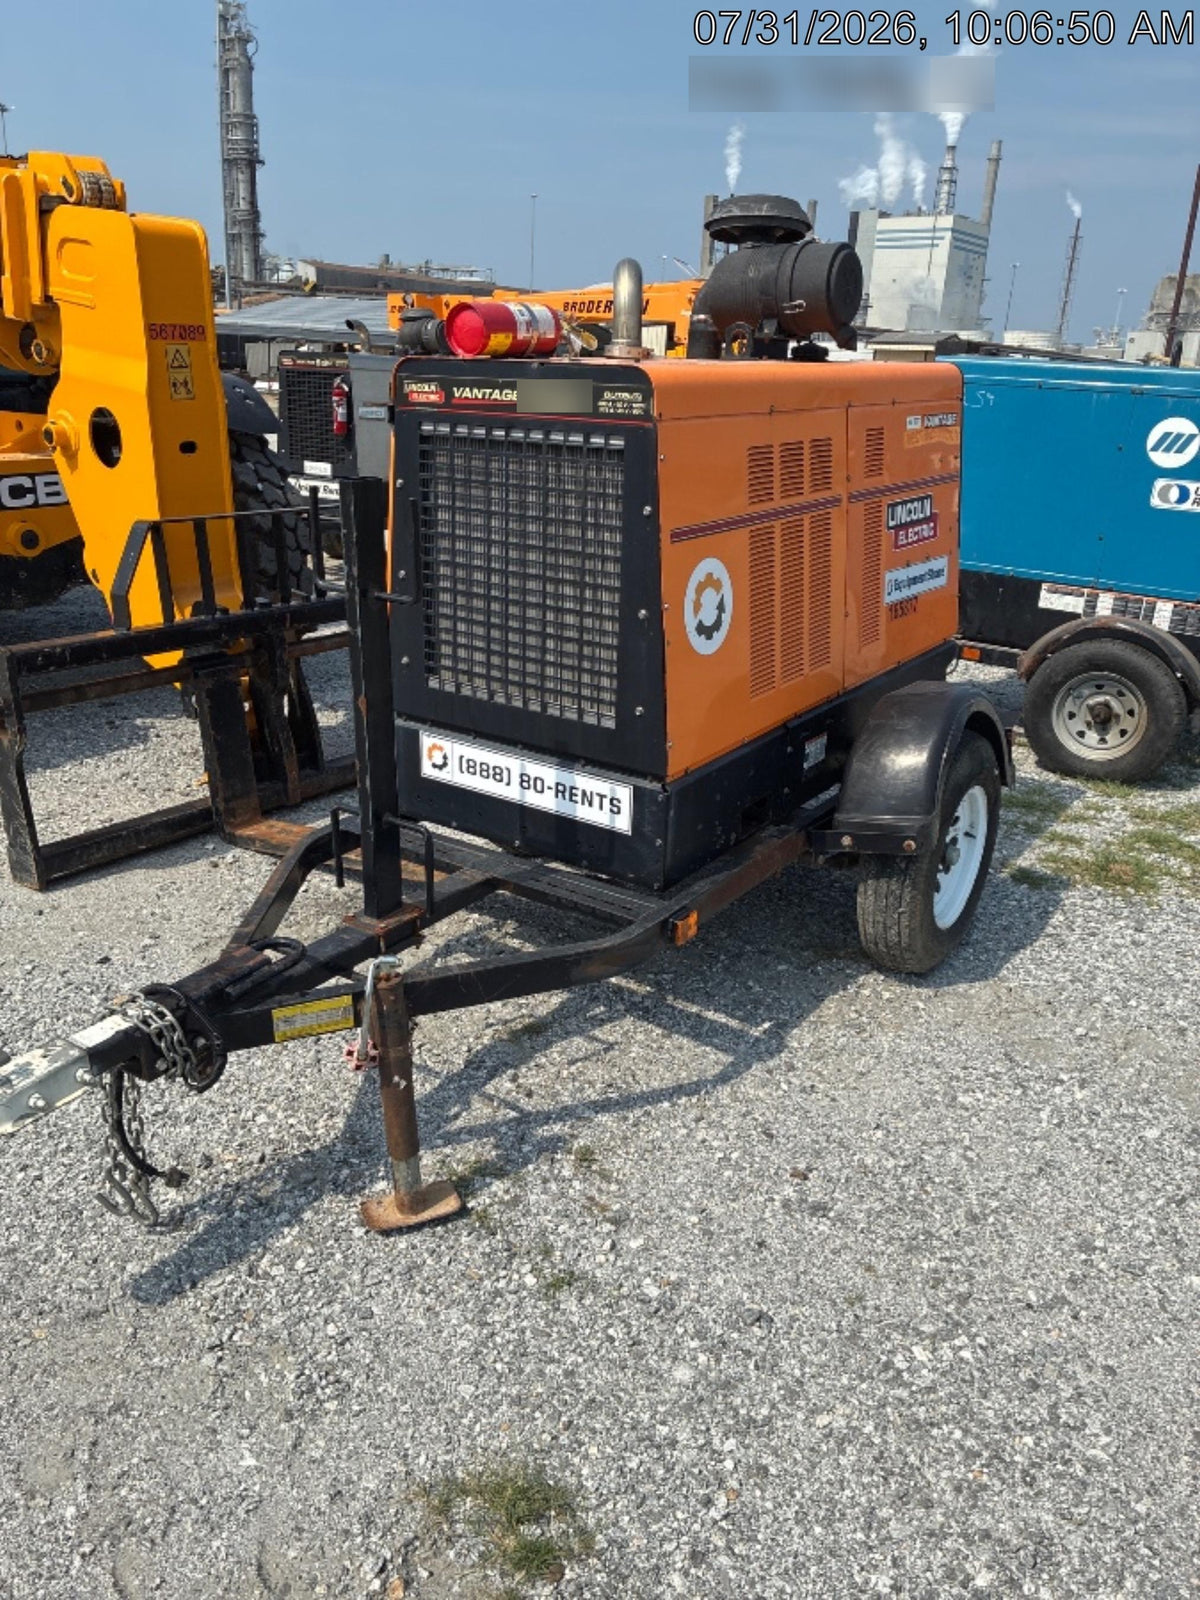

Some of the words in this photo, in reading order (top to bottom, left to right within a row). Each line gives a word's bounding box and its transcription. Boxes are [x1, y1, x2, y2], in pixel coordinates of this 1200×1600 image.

[563, 299, 649, 315] BRODER
[0, 474, 67, 507] CB
[888, 498, 931, 527] LINCOLN
[898, 522, 935, 546] ELECTRIC
[458, 754, 511, 786] (888)
[519, 772, 622, 815] 80-RENTS
